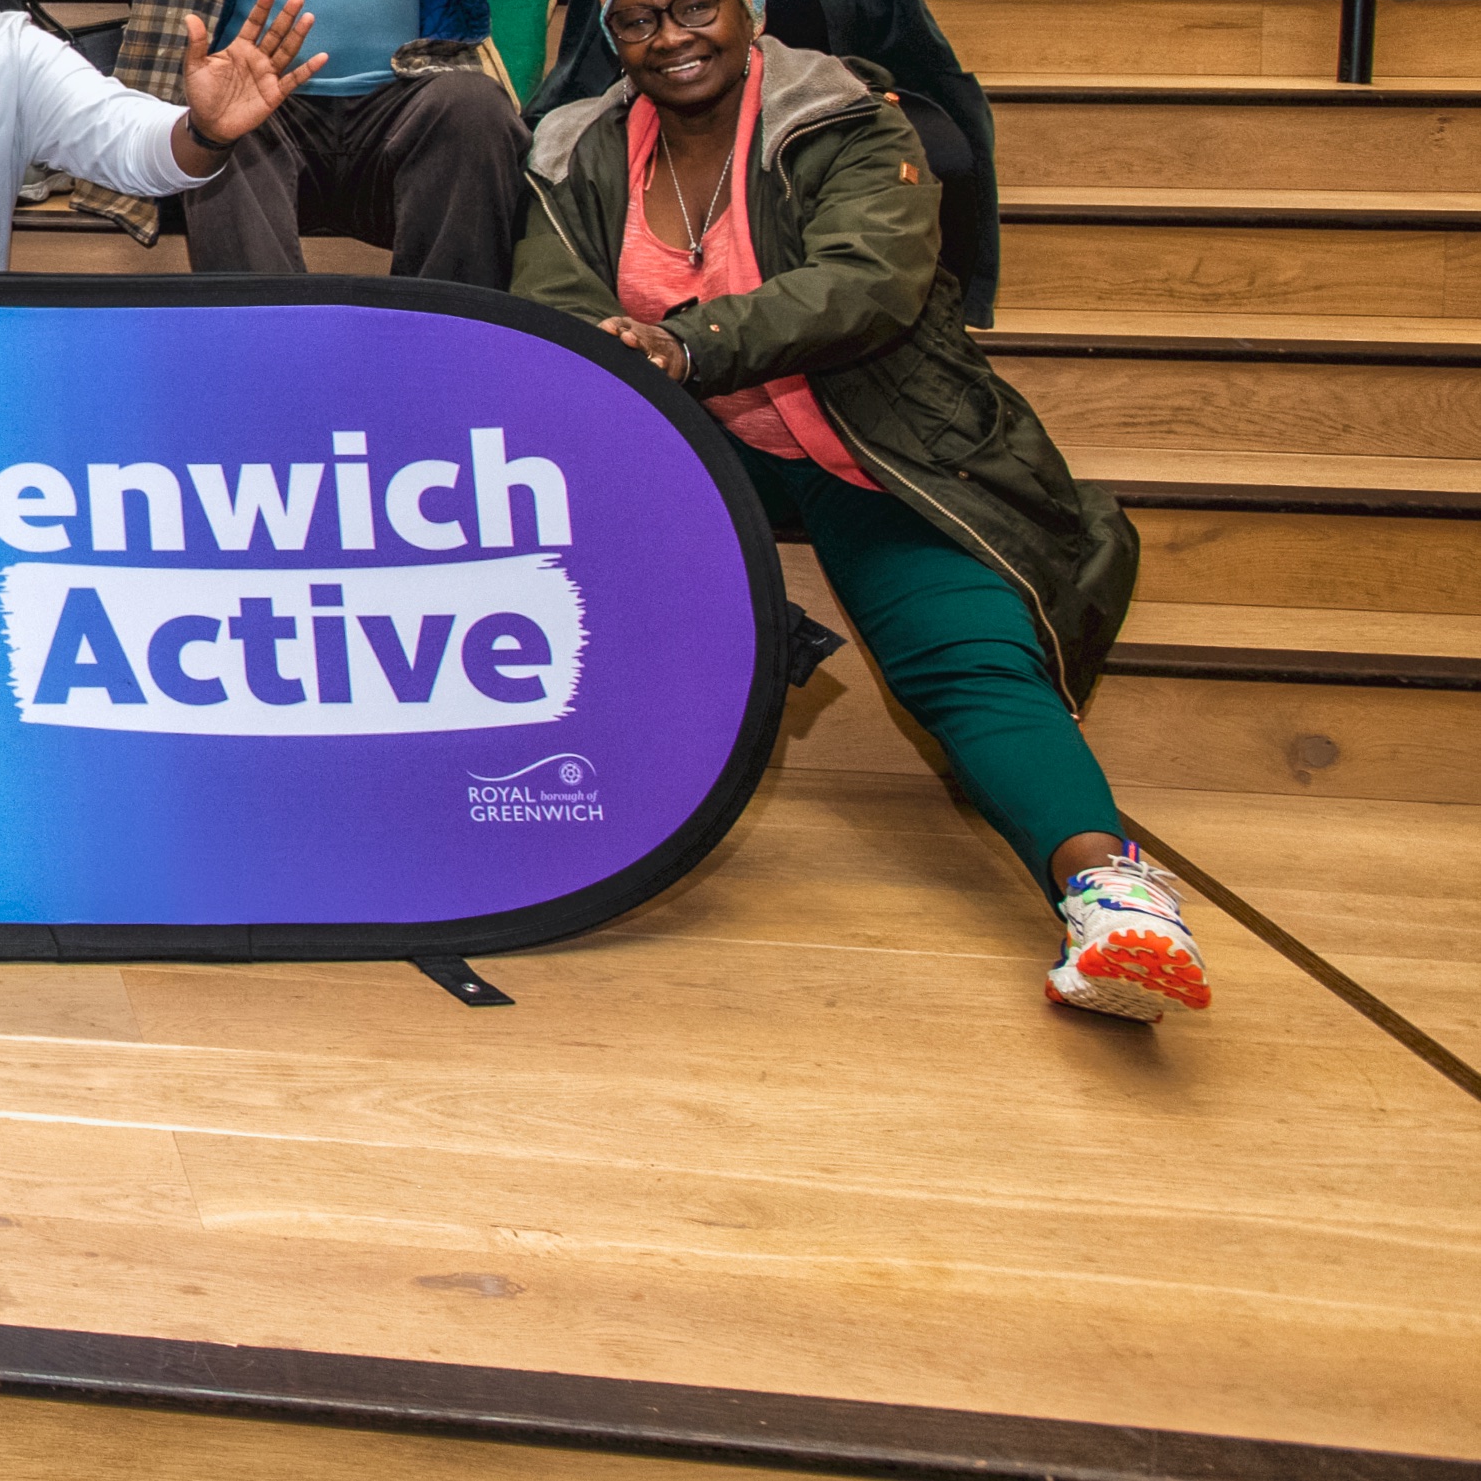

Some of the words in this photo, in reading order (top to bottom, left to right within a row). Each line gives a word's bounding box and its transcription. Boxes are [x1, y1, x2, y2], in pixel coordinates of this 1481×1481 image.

[35, 583, 553, 708] Active
[468, 786, 536, 803] ROYAL
[540, 790, 585, 804] borough
[586, 789, 599, 803] of
[470, 804, 604, 822] GREENWICH
